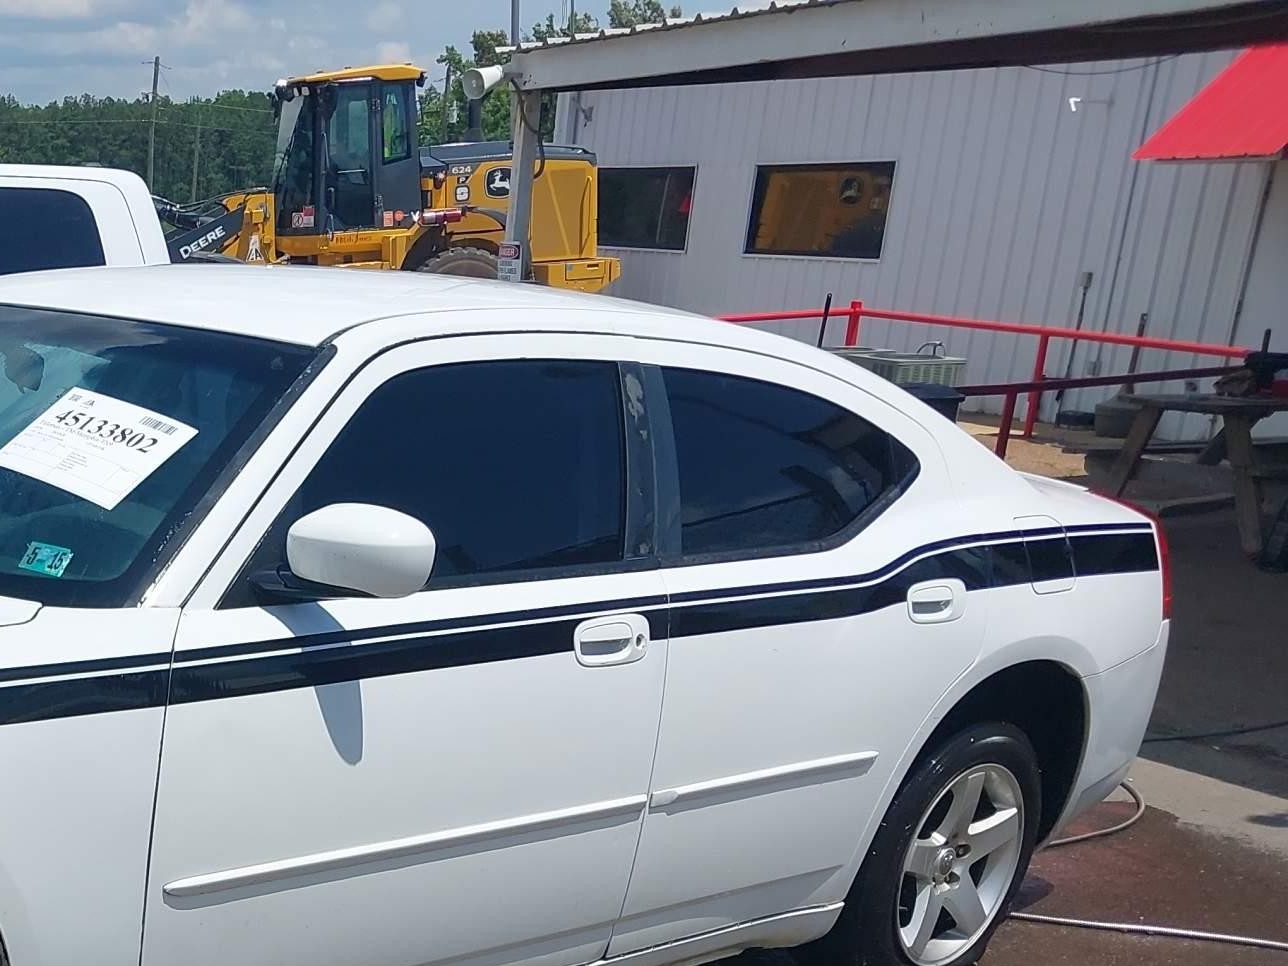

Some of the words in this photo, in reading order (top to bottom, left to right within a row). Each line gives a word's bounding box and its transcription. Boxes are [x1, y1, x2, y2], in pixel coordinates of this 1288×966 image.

[452, 165, 472, 175] 624
[178, 225, 226, 260] DEERE
[55, 409, 159, 454] 45133802
